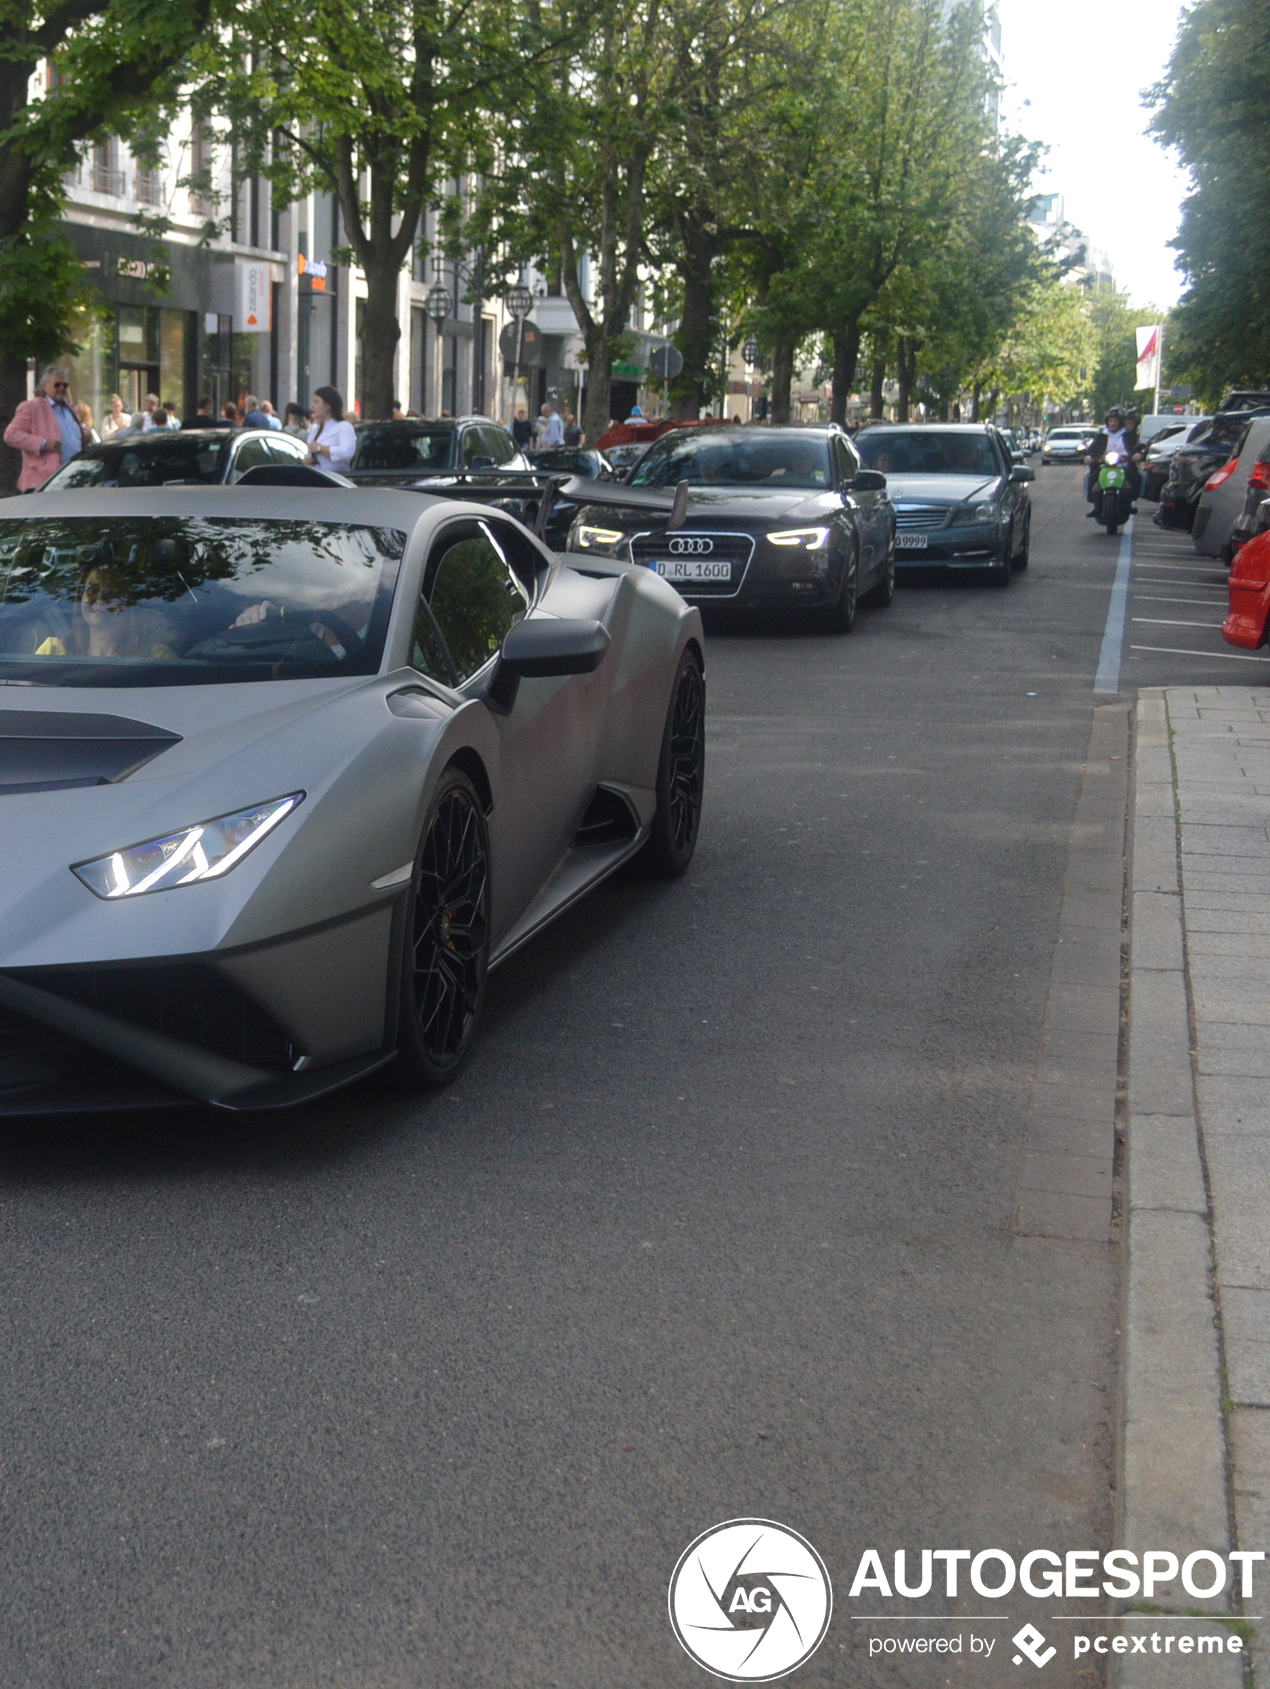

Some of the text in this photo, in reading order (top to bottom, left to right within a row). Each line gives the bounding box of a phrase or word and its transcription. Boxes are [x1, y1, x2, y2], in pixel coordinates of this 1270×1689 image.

[902, 536, 926, 546] 9999
[658, 563, 729, 578] D RL 1600
